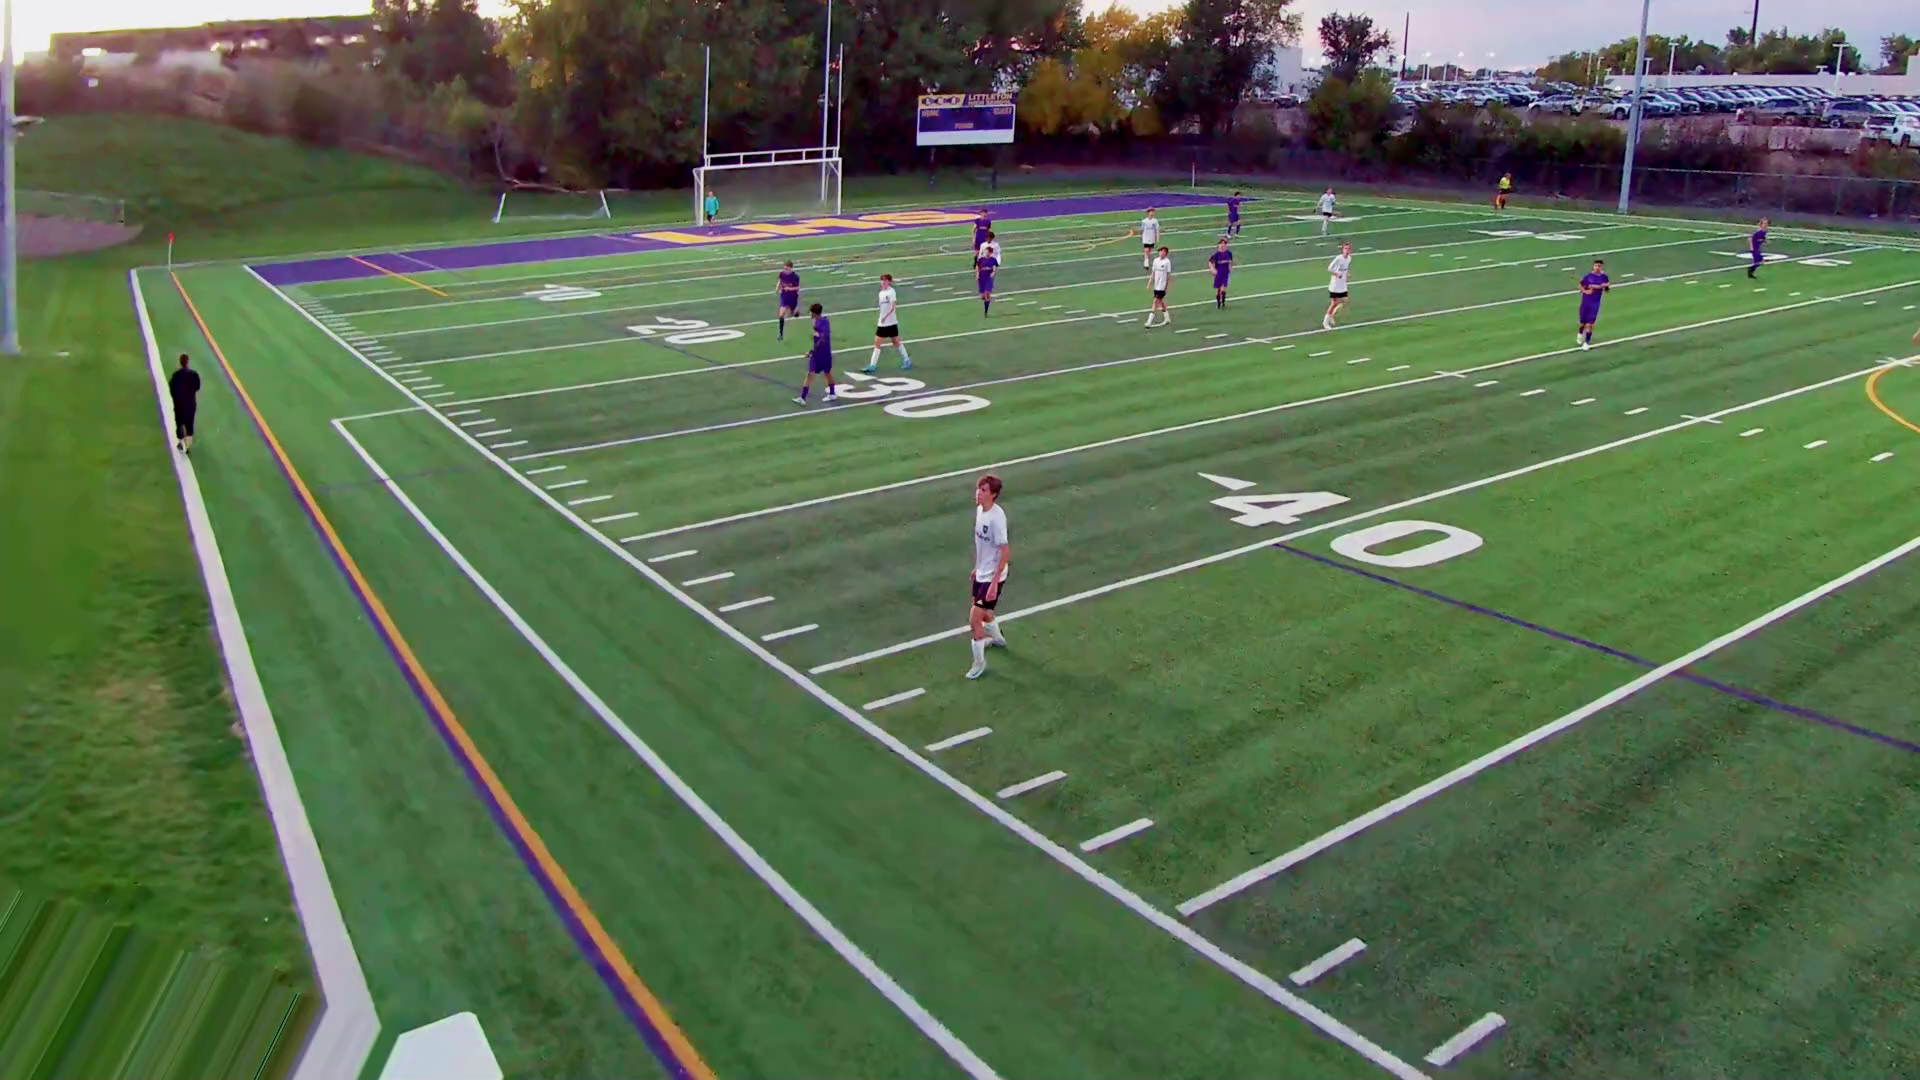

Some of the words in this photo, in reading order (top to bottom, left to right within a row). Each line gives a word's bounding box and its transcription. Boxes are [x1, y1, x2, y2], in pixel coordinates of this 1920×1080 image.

[625, 316, 746, 345] 20
[834, 376, 992, 418] 30
[1209, 490, 1484, 568] 40
